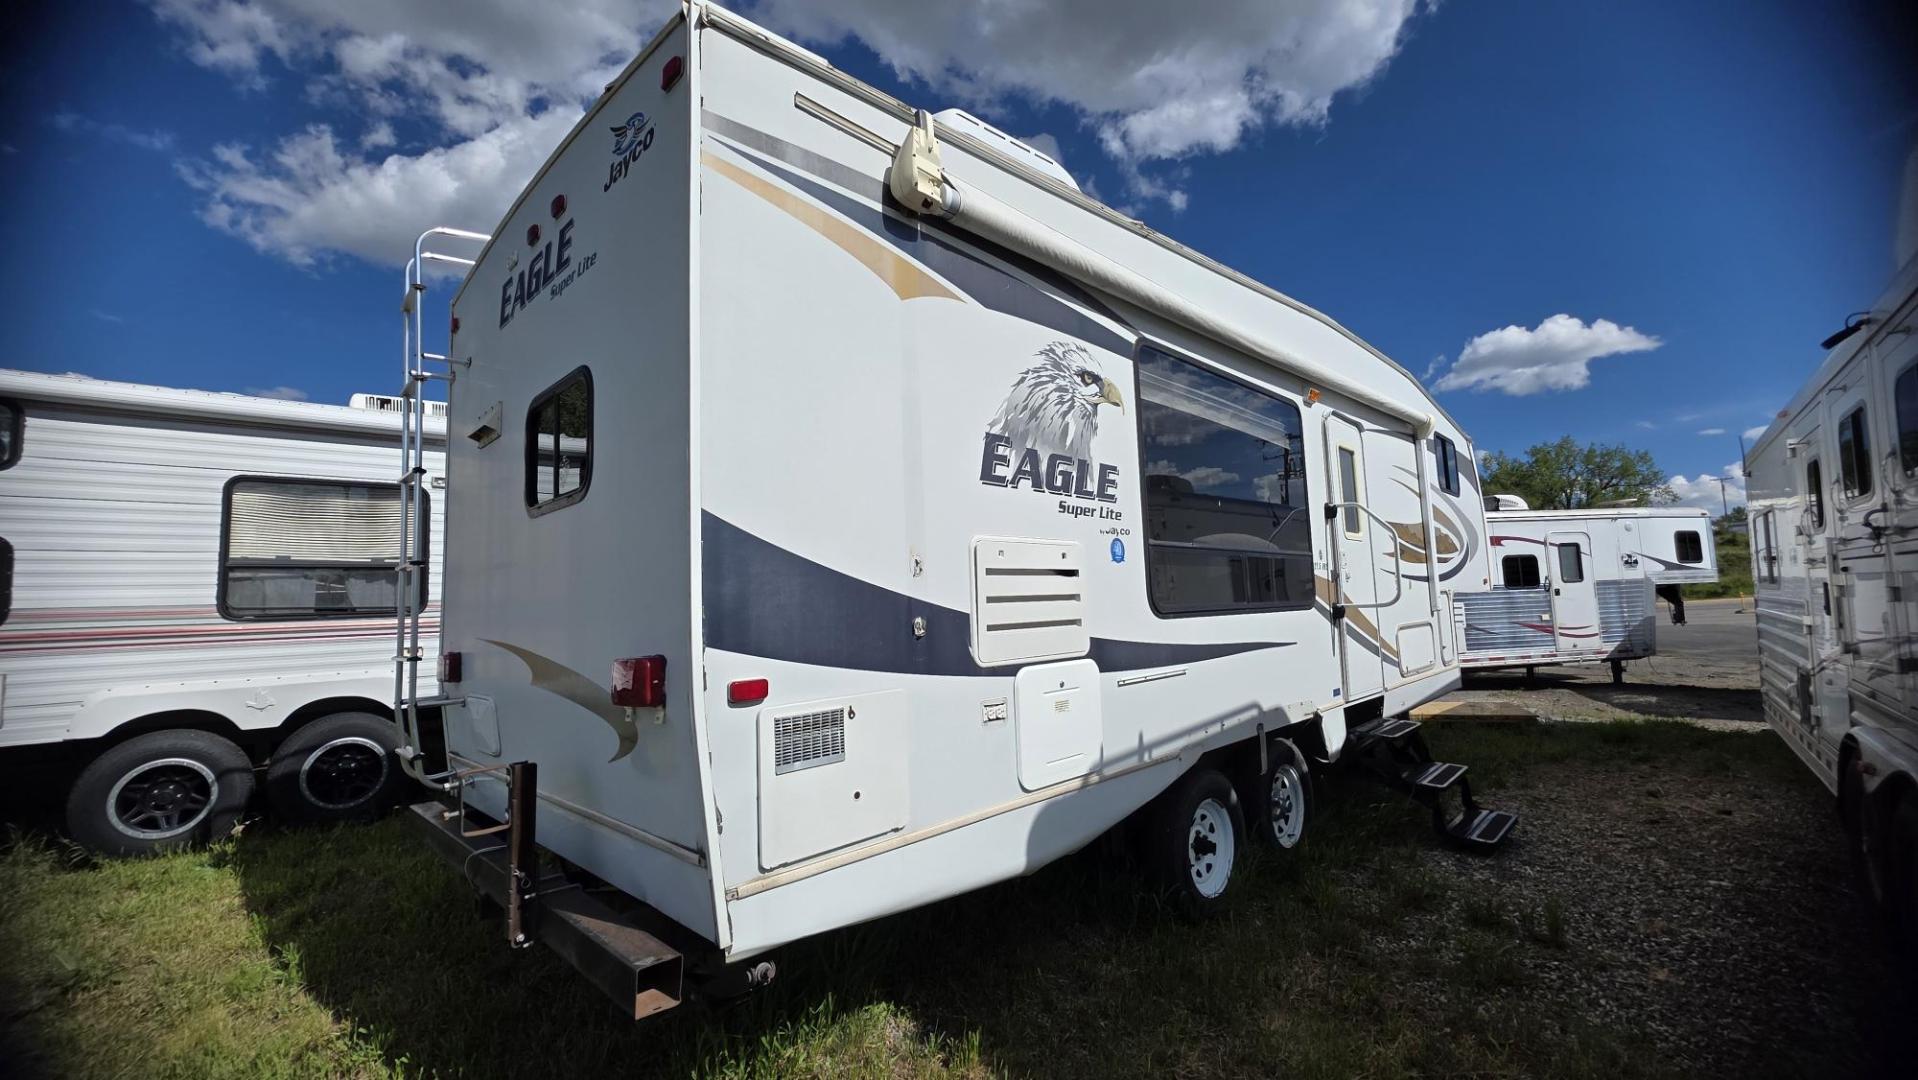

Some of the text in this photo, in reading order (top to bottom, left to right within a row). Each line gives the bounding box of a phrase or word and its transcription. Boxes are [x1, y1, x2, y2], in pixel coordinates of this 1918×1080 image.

[603, 127, 655, 193] Jayco
[499, 216, 575, 331] EAGLE
[550, 251, 597, 301] Super Lite
[979, 431, 1120, 504] EAGLE
[1058, 500, 1122, 521] Super Lite
